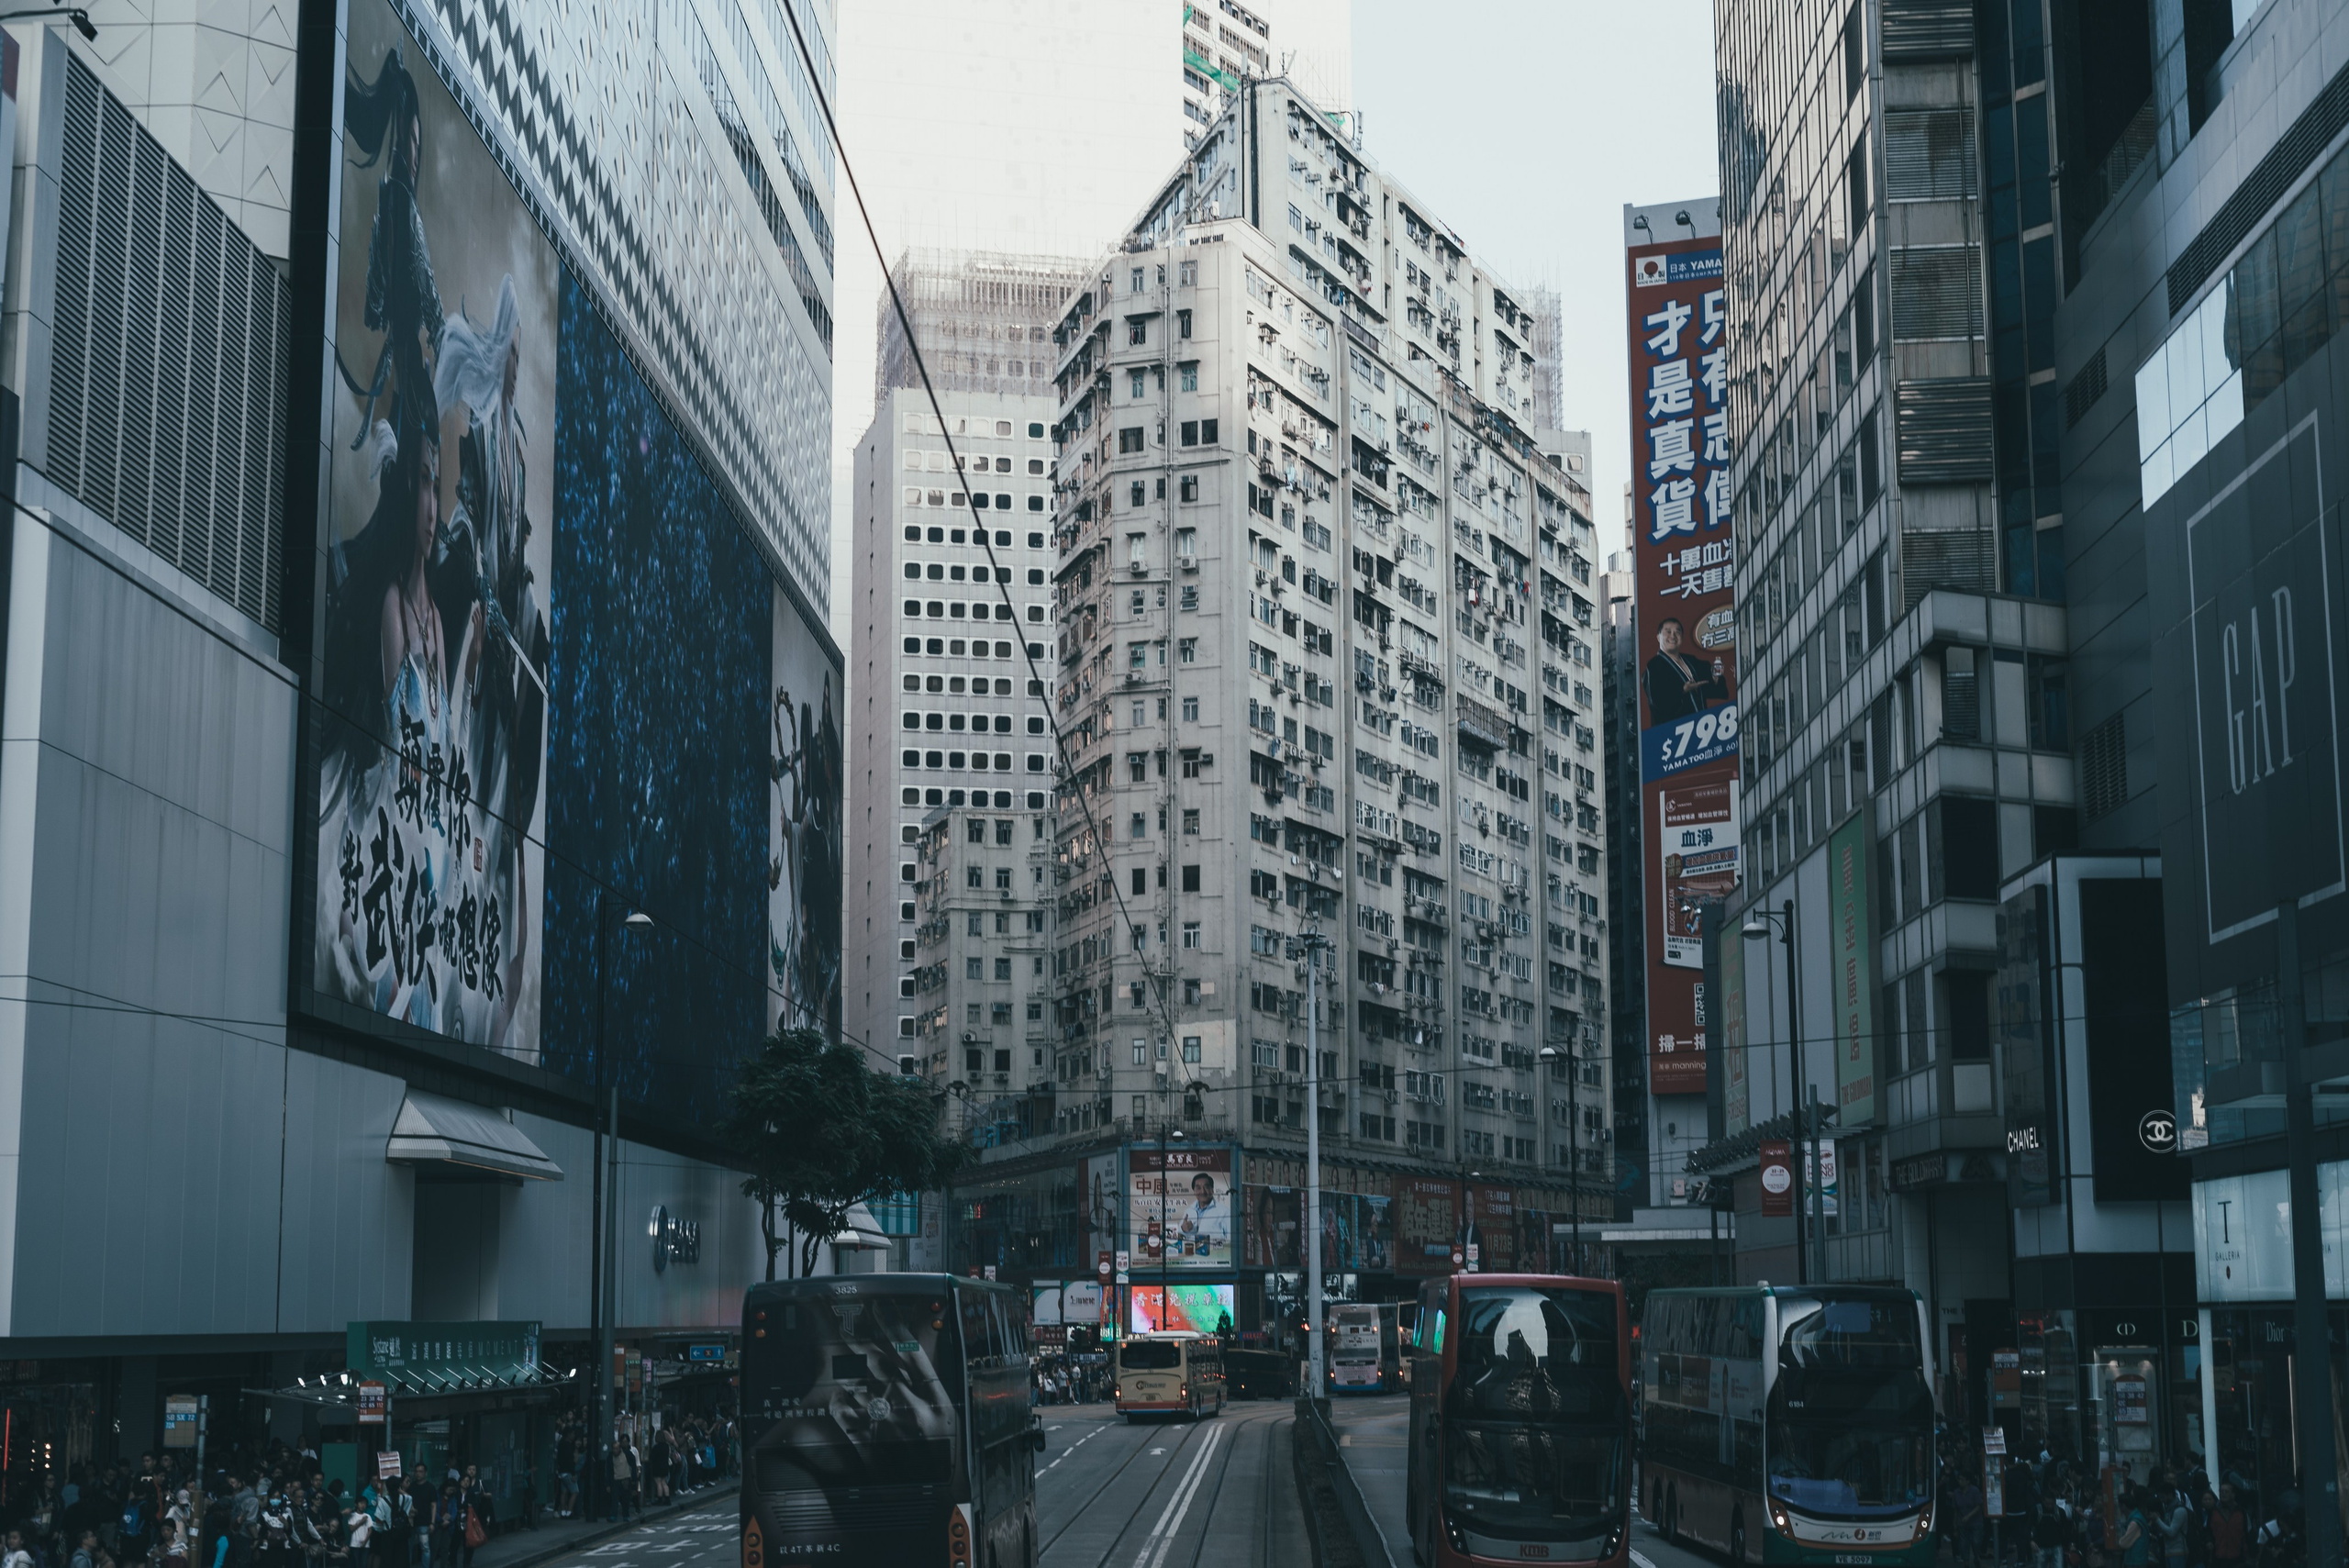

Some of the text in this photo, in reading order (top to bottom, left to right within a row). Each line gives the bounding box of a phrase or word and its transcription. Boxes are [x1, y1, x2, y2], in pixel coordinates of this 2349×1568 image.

[1670, 262, 1687, 273] 日本
[1647, 300, 1697, 539] 才是真貨
[2223, 585, 2295, 795] GAP
[1662, 705, 1738, 762] $798
[1681, 828, 1713, 848] 血淨
[1841, 1075, 1872, 1106] THE GOLDMARK
[2008, 1127, 2039, 1153] CHANEL
[1896, 1155, 1943, 1186] THE GOLDMARK
[2218, 1200, 2232, 1243] T
[1486, 1234, 1512, 1253] 11月23日
[2215, 1250, 2241, 1262] GALLERIA
[835, 1285, 858, 1295] 3825
[2266, 1321, 2285, 1342] Dior
[478, 1340, 518, 1356] MOMENT
[1788, 1400, 1804, 1408] 6184
[580, 1540, 700, 1556] 巴士
[1520, 1543, 1550, 1557] KMB
